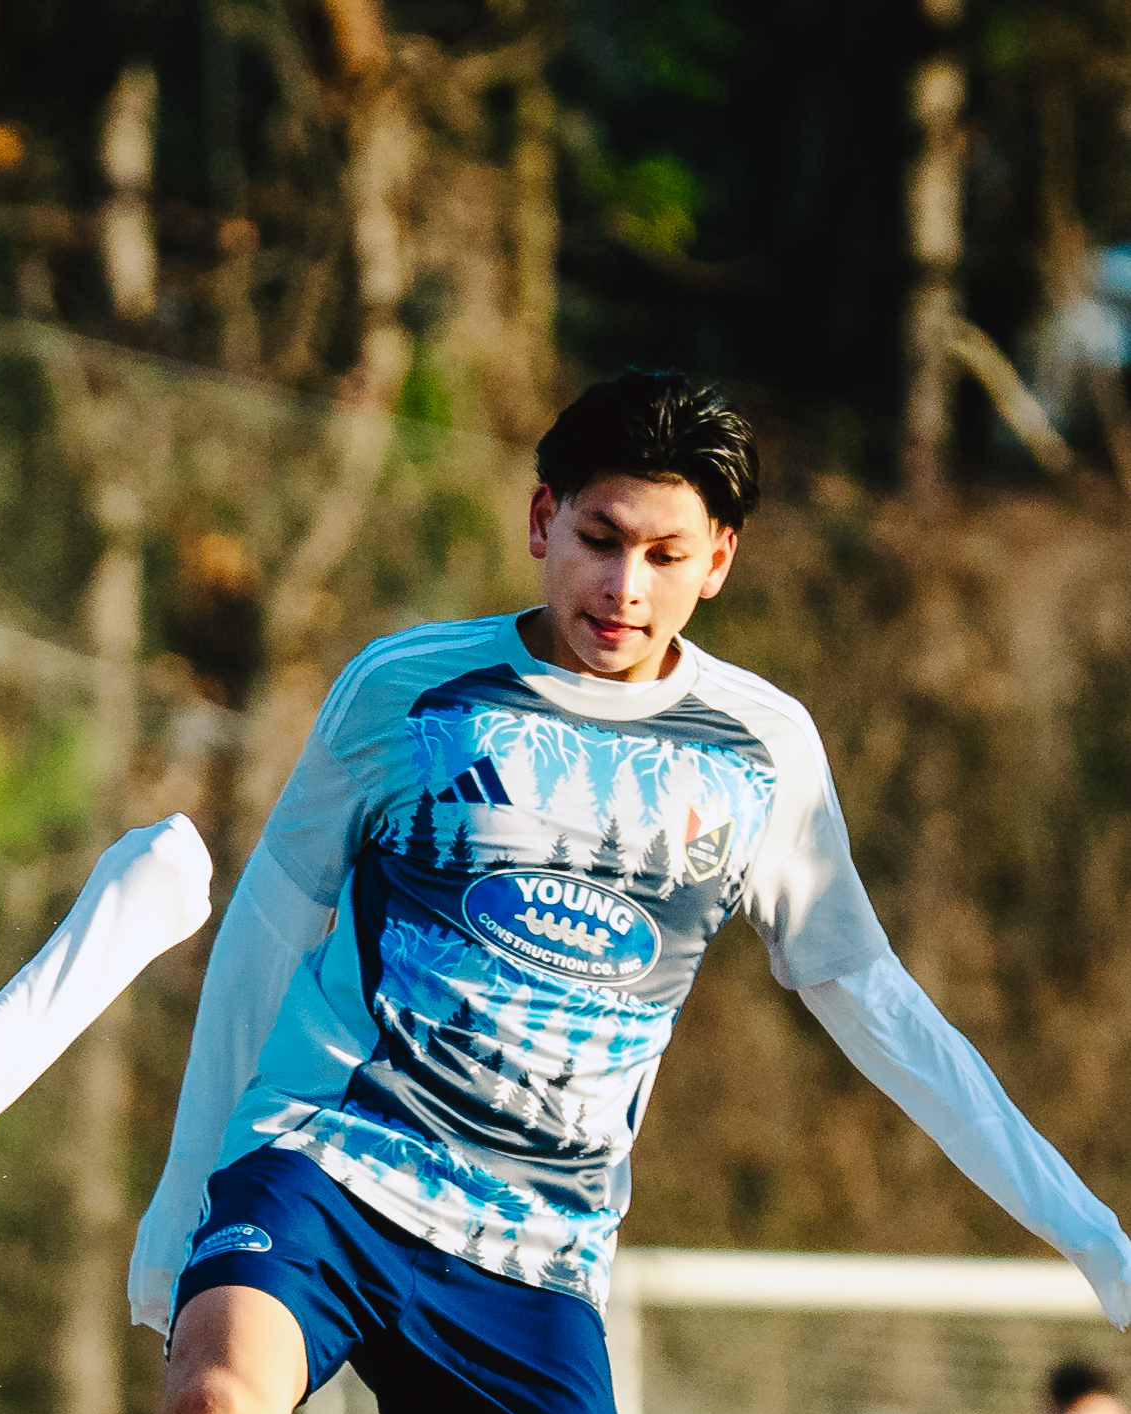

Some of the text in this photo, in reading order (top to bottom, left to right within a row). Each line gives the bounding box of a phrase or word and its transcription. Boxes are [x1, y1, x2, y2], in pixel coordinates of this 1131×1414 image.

[514, 877, 635, 936] YOUNG
[478, 912, 589, 973] CONSTRUCTION
[591, 961, 616, 976] CO.
